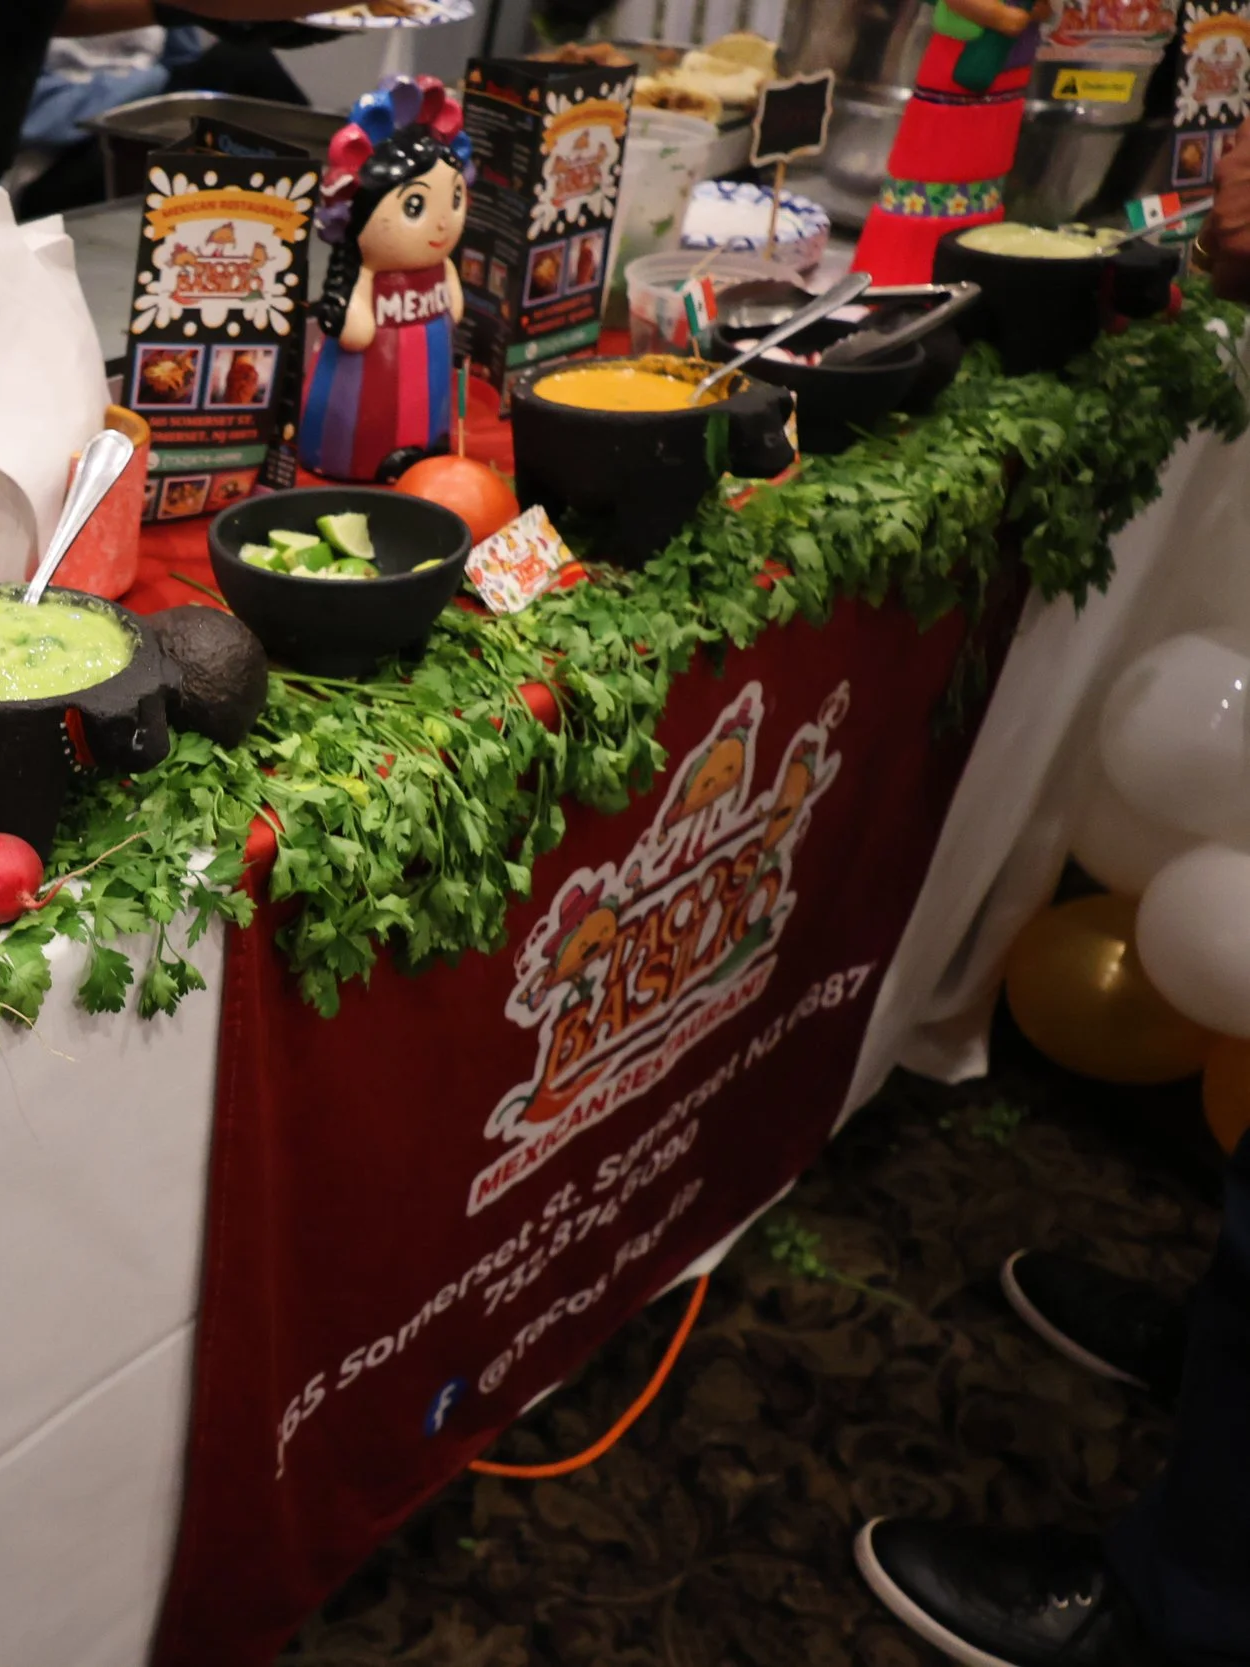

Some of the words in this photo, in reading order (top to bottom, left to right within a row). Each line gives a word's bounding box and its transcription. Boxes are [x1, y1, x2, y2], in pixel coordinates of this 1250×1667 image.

[547, 867, 782, 1083] BASILIO
[612, 838, 763, 982] TACOS
[336, 1220, 533, 1390] Somerset
[539, 1182, 583, 1233] St.
[593, 1053, 739, 1193] Somerset
[477, 1088, 610, 1201] MEXICAN
